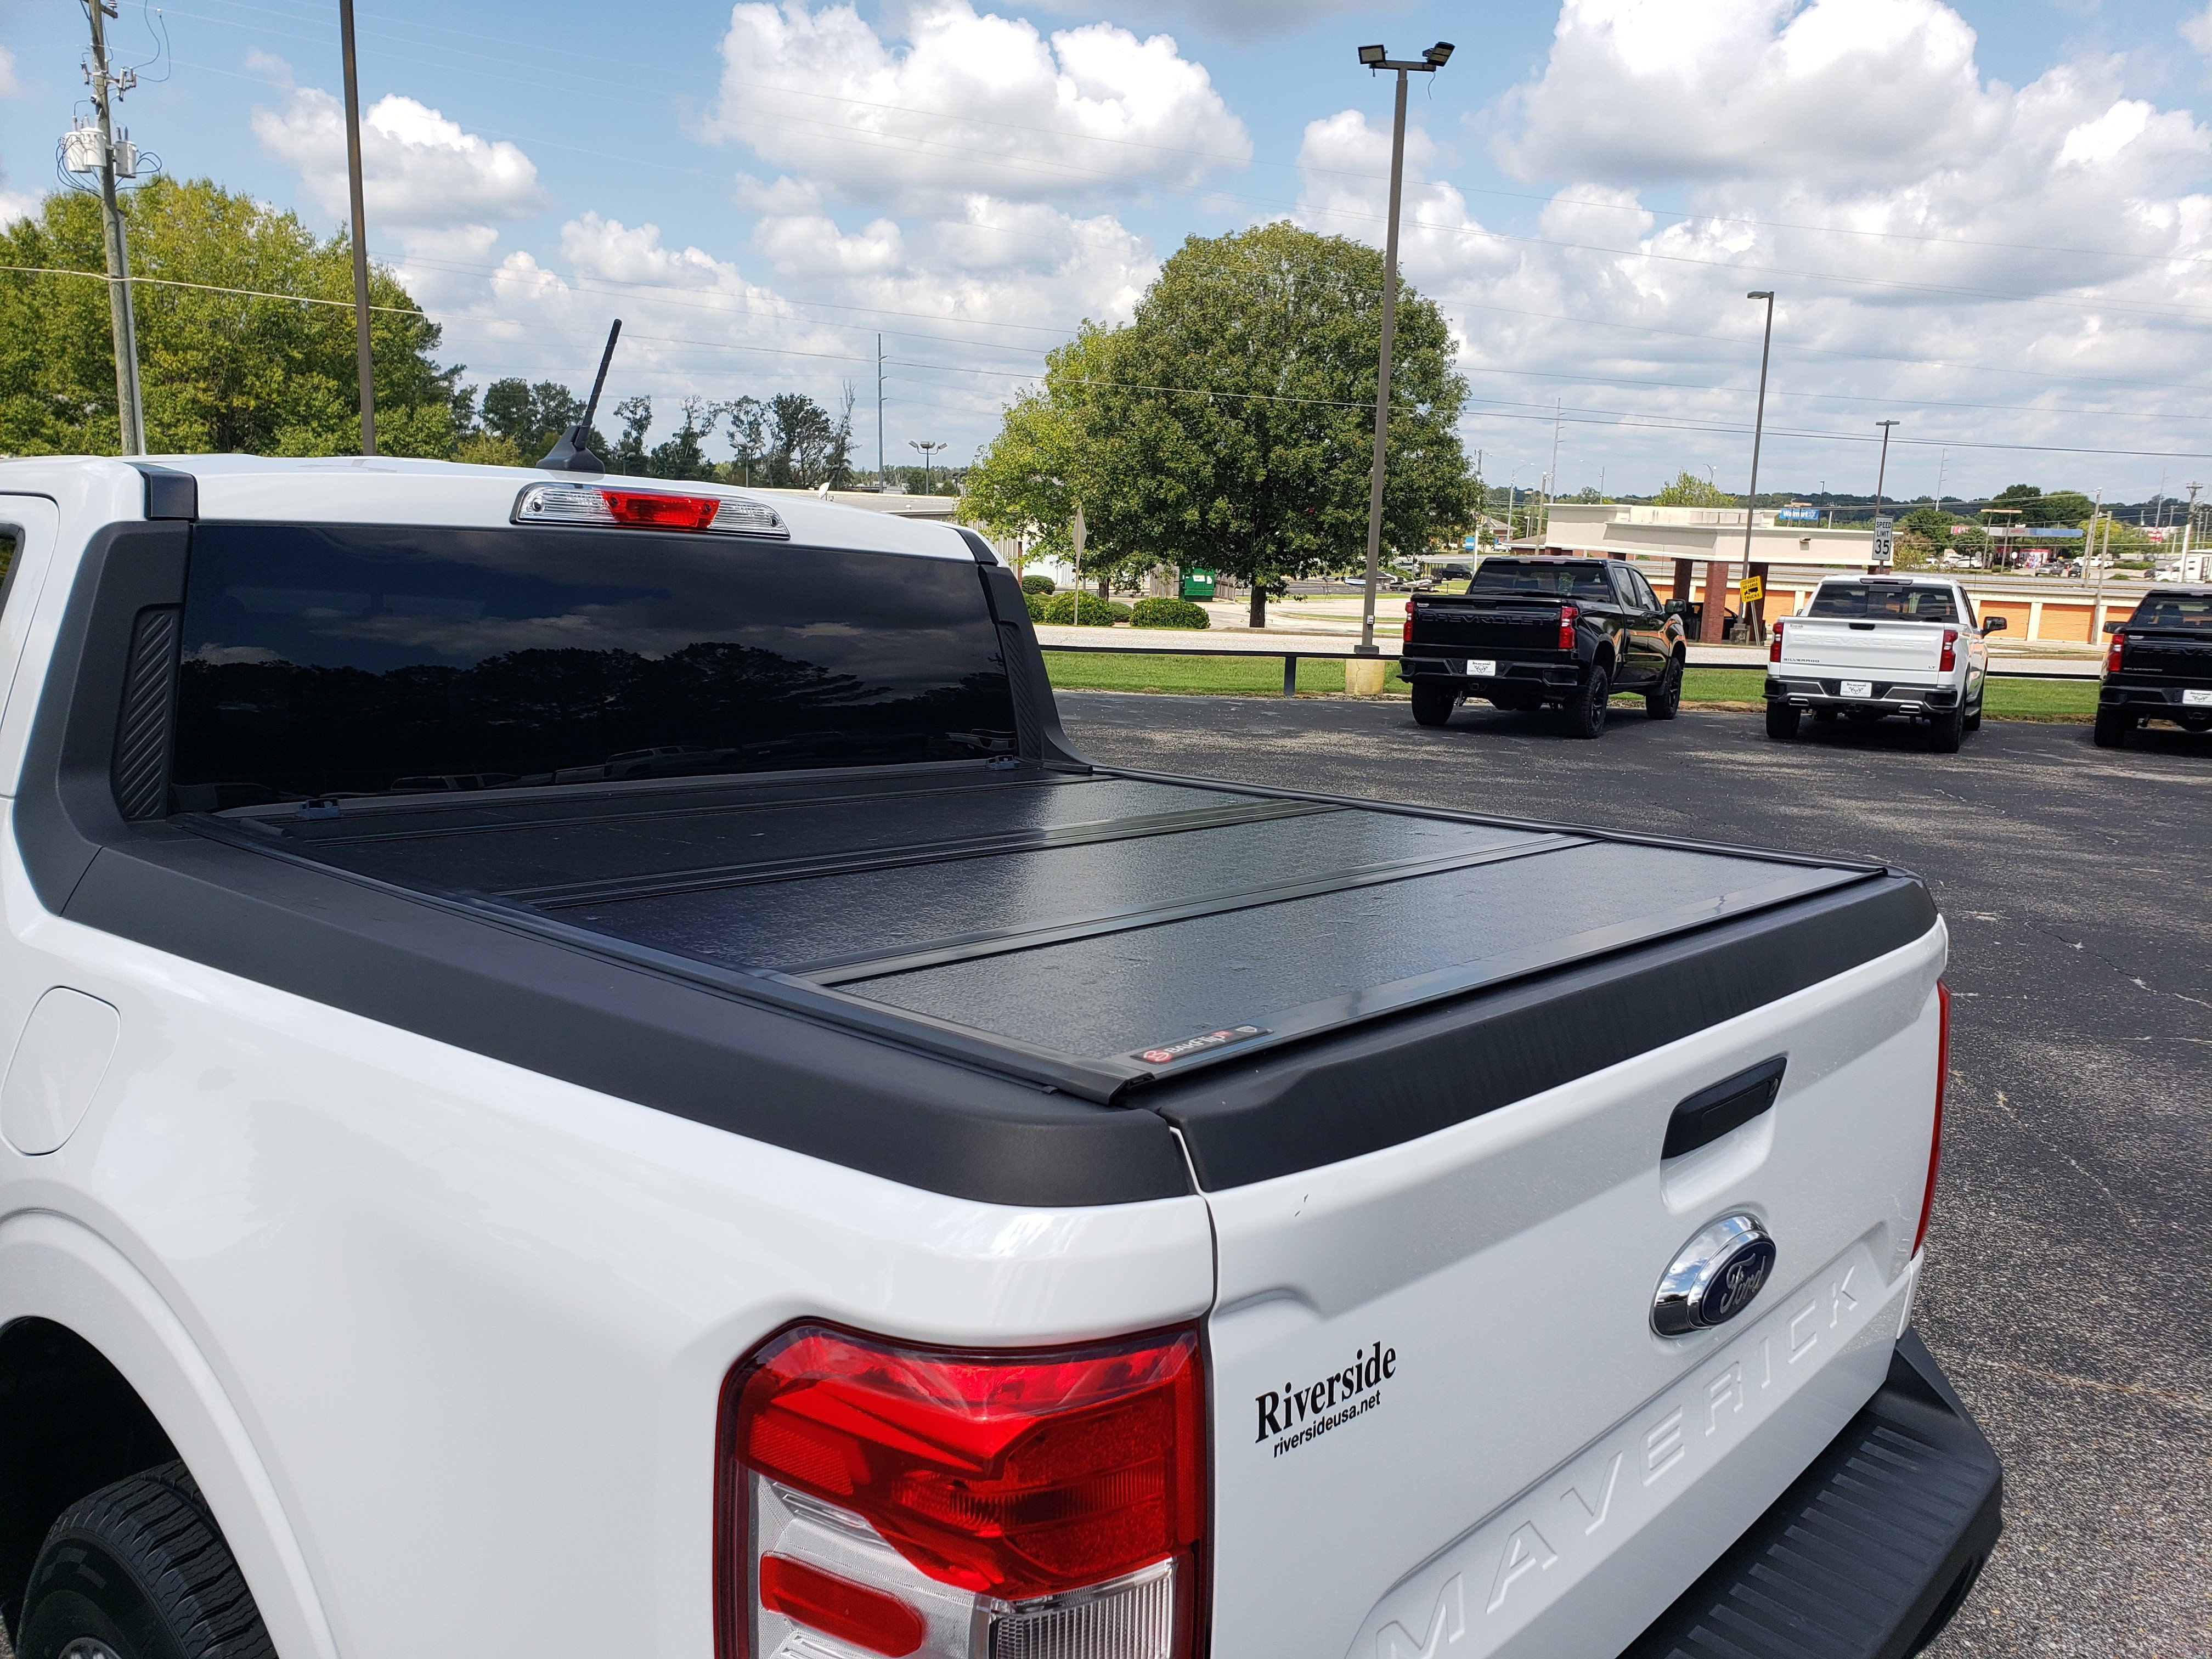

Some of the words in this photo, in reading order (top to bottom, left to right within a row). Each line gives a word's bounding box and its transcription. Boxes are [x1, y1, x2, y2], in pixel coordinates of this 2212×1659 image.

[1875, 539, 1889, 555] 35
[1421, 613, 1544, 626] CHEVROLET
[1792, 635, 1932, 649] CHEVROLET
[1719, 1252, 1766, 1314] Ford
[1255, 1340, 1396, 1444] Riverside
[1273, 1389, 1381, 1458] riversideusa.net
[1375, 1264, 1858, 1659] MAVERICK
